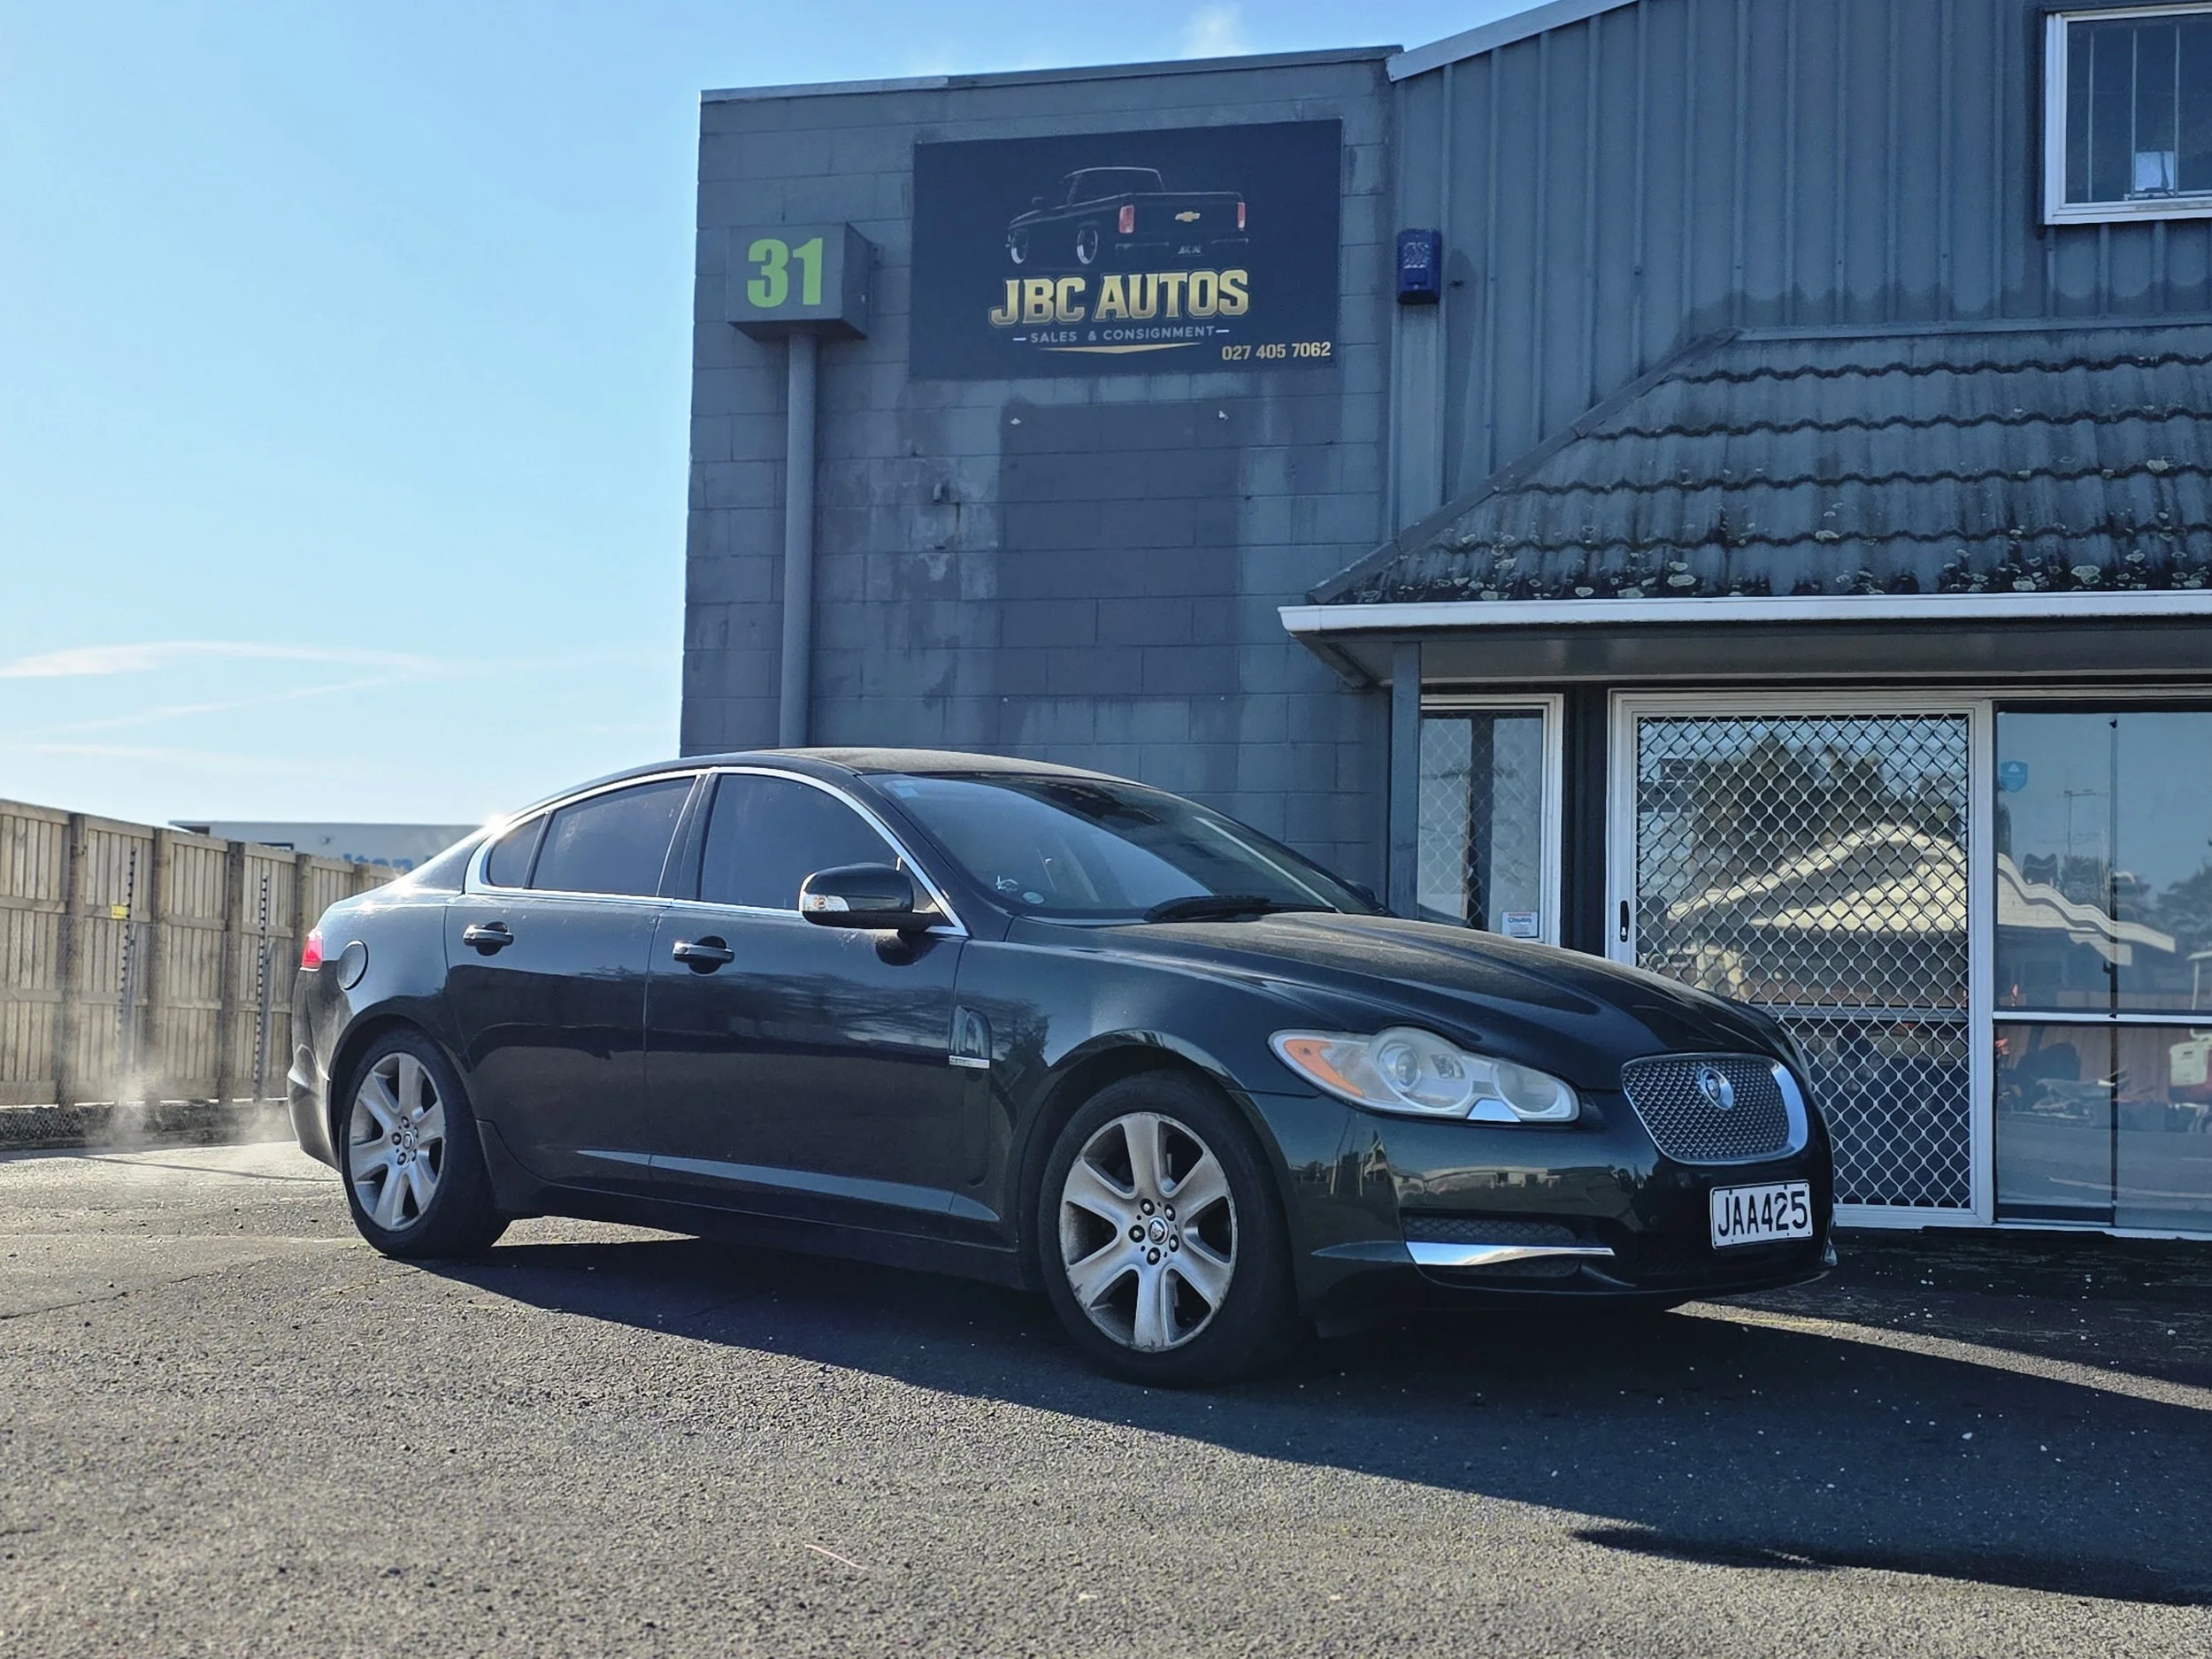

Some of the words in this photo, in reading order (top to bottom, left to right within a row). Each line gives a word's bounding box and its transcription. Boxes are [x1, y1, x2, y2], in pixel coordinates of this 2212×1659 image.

[747, 237, 823, 308] 31
[990, 276, 1087, 326] JBC
[1094, 269, 1250, 320] AUTOS
[1030, 331, 1078, 343] SALES
[1087, 330, 1097, 342] &
[1102, 326, 1215, 341] CONSIGNMENT
[1222, 345, 1252, 360] 027
[1256, 343, 1286, 359] 405
[1292, 341, 1332, 357] 7062
[1718, 1190, 1808, 1237] JAA425
